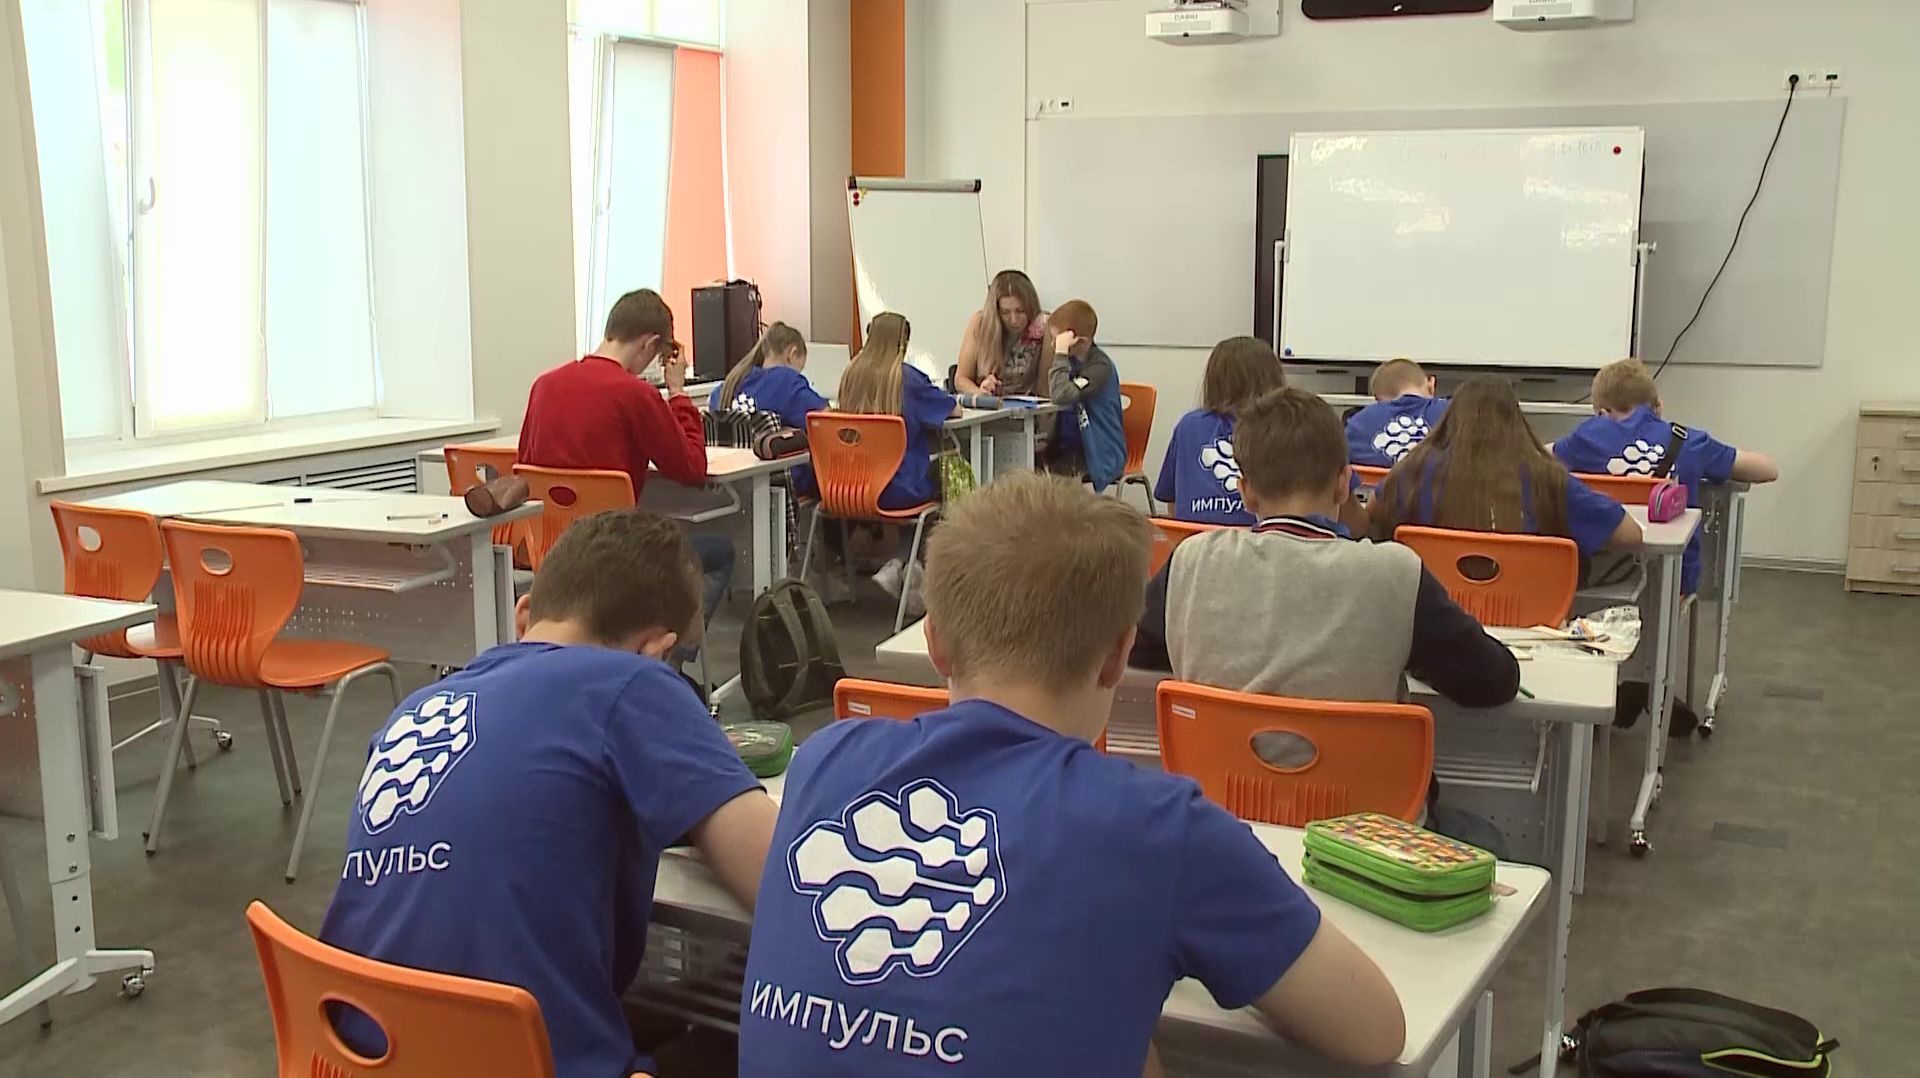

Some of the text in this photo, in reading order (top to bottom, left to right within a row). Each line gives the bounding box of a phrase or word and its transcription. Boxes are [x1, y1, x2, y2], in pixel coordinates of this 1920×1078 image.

[1191, 497, 1244, 513] импул
[342, 842, 451, 886] пульс
[750, 979, 968, 1063] импульс
